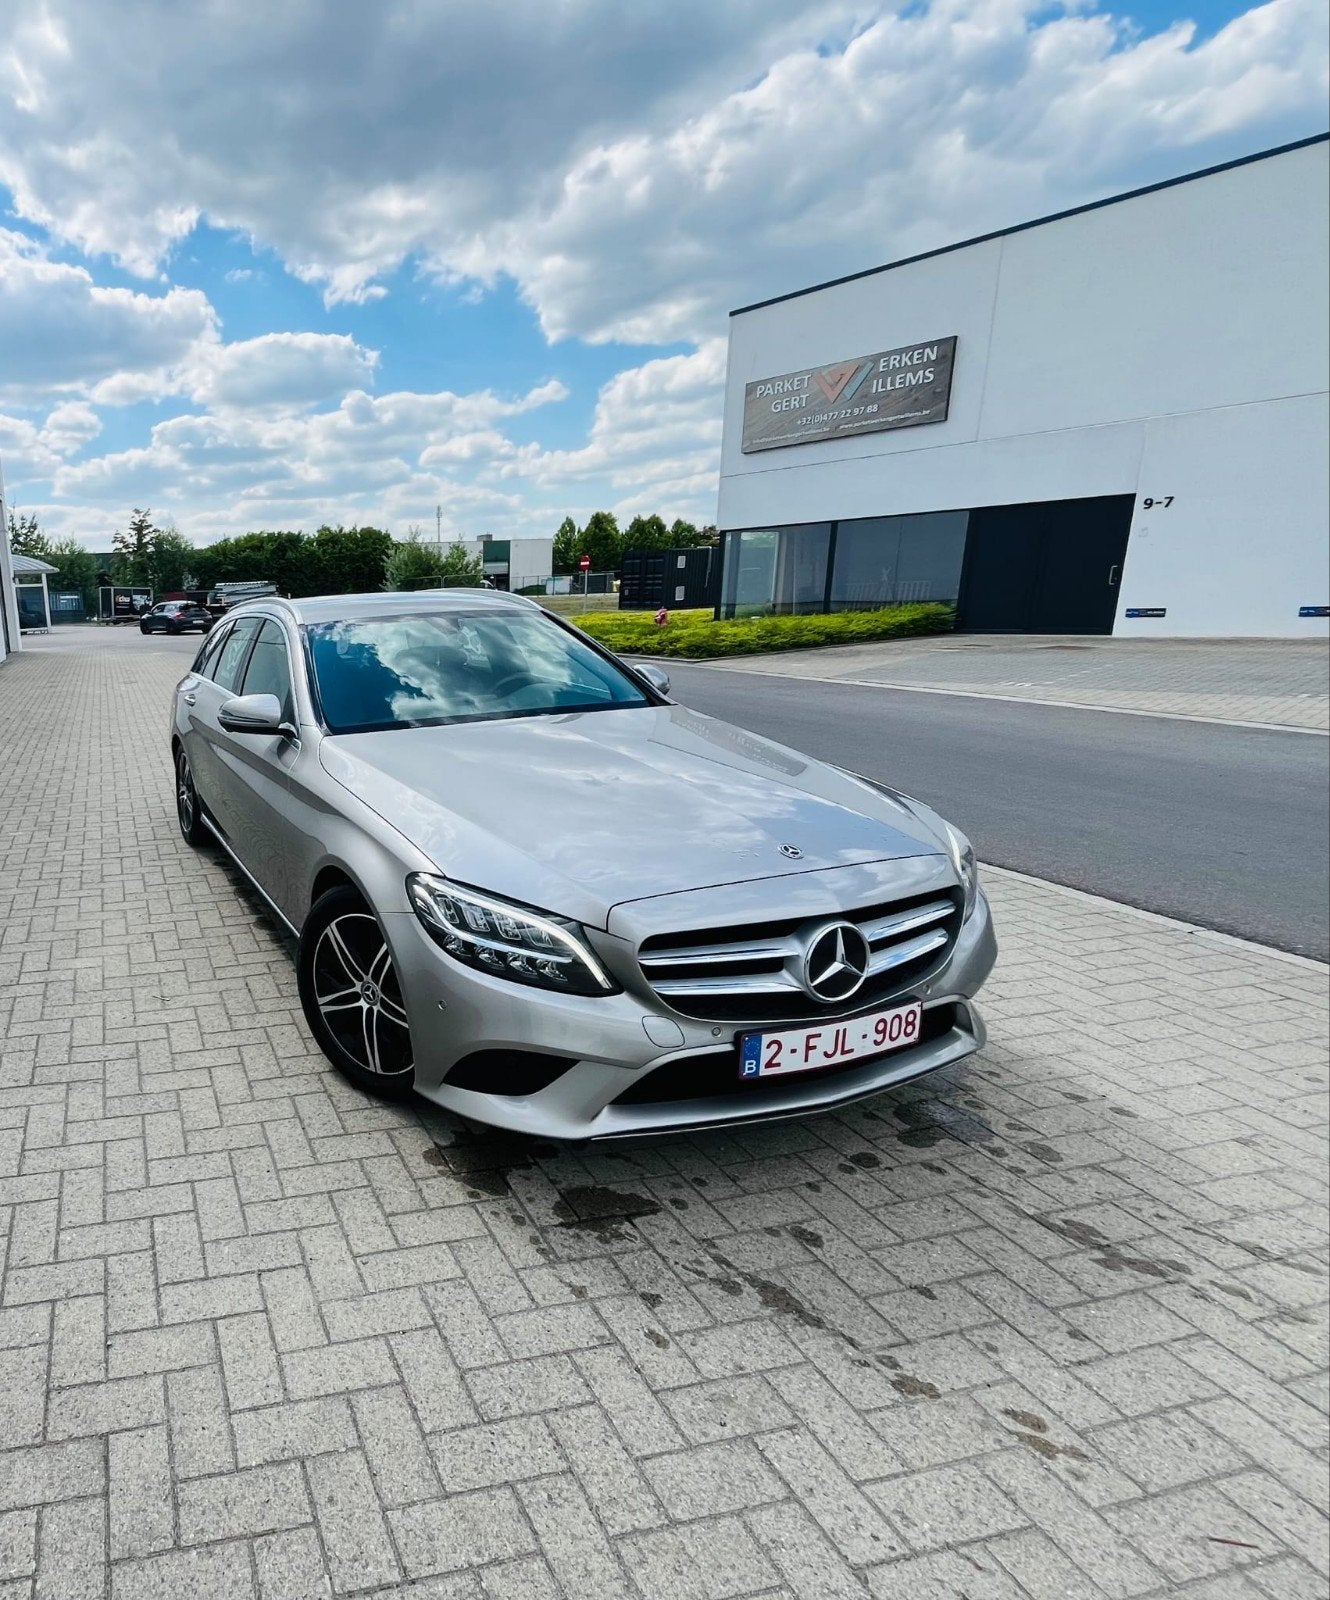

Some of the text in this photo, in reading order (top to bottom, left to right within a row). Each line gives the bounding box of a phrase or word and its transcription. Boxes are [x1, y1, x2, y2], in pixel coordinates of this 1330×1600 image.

[756, 374, 812, 398] PARKET
[879, 346, 938, 372] ERKEN
[771, 368, 935, 413] GERT ILLEMS
[839, 409, 851, 419] 22
[852, 406, 865, 416] 97
[866, 403, 879, 413] 88
[1143, 496, 1175, 510] 9-7
[744, 1009, 918, 1074] B 2-FJL-908
